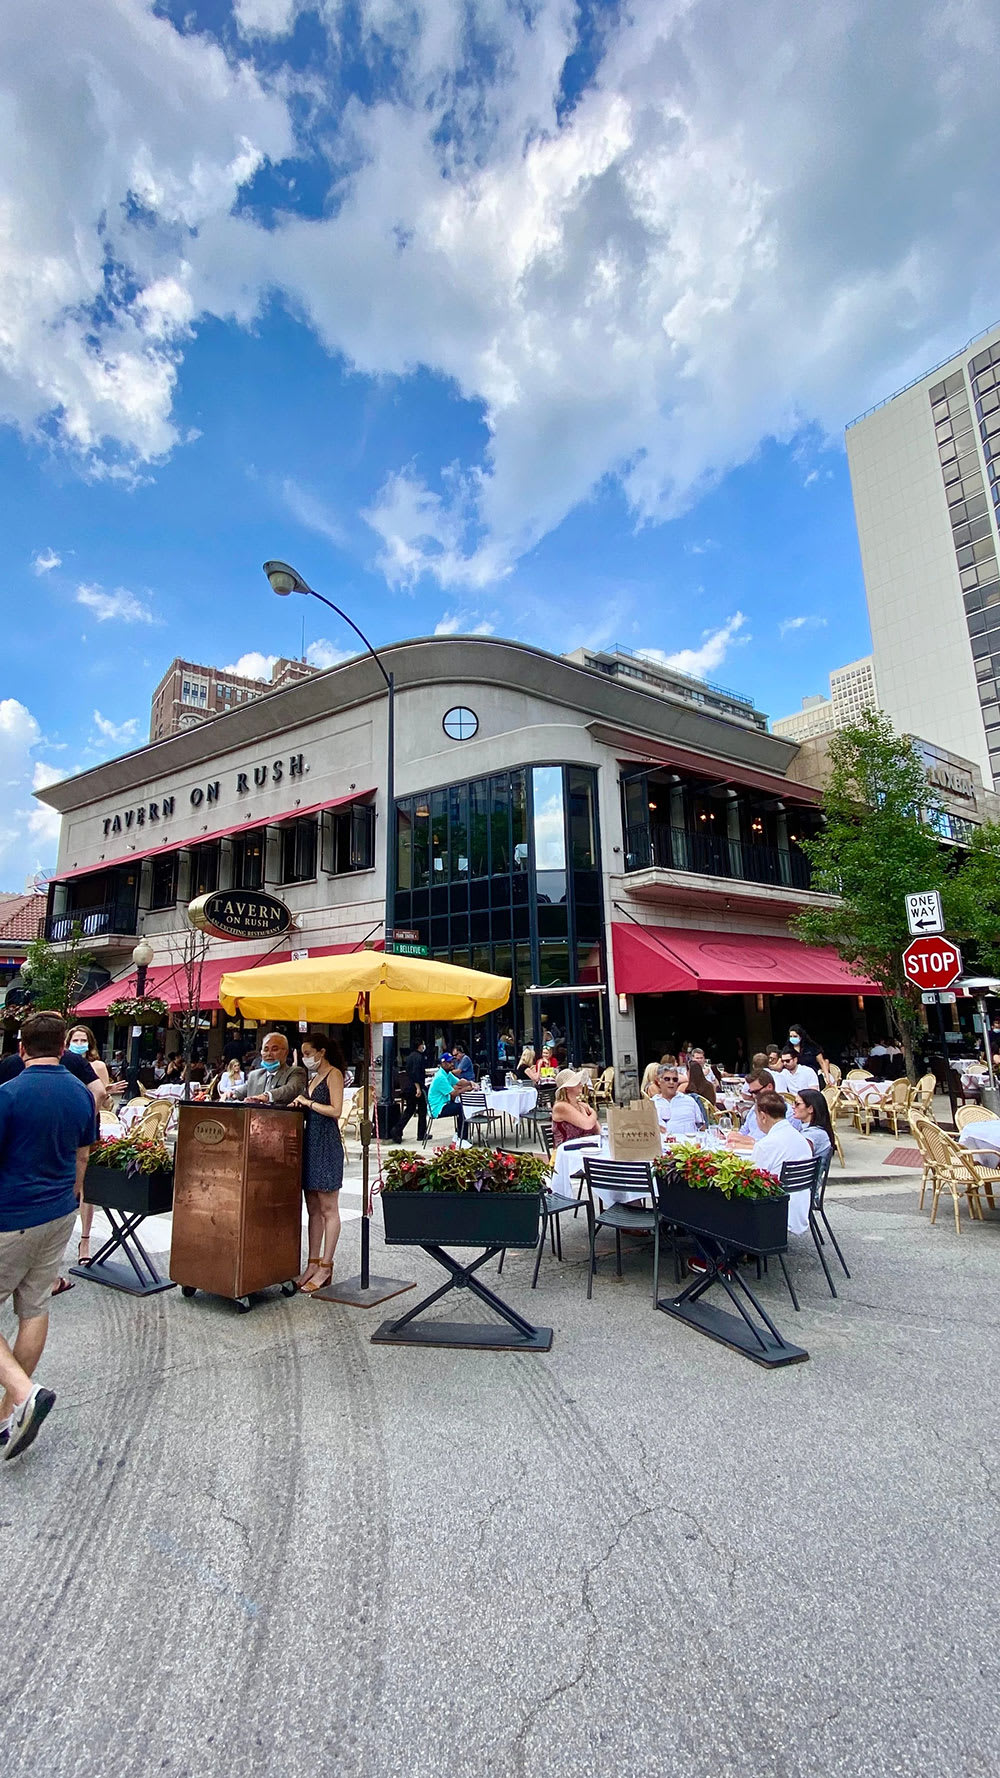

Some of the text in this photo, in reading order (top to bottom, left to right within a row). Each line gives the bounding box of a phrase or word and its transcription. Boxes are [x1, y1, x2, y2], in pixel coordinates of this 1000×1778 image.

[103, 796, 175, 835] TAVERN
[190, 781, 220, 807] ON
[910, 895, 935, 907] ONE
[211, 899, 281, 920] TAVERN
[911, 906, 936, 918] WAY
[226, 915, 269, 927] ON RUSH
[220, 923, 247, 936] EXCITING
[247, 926, 281, 937] RESTAURANT
[400, 944, 421, 955] BELLEVUE
[908, 952, 955, 974] STOP
